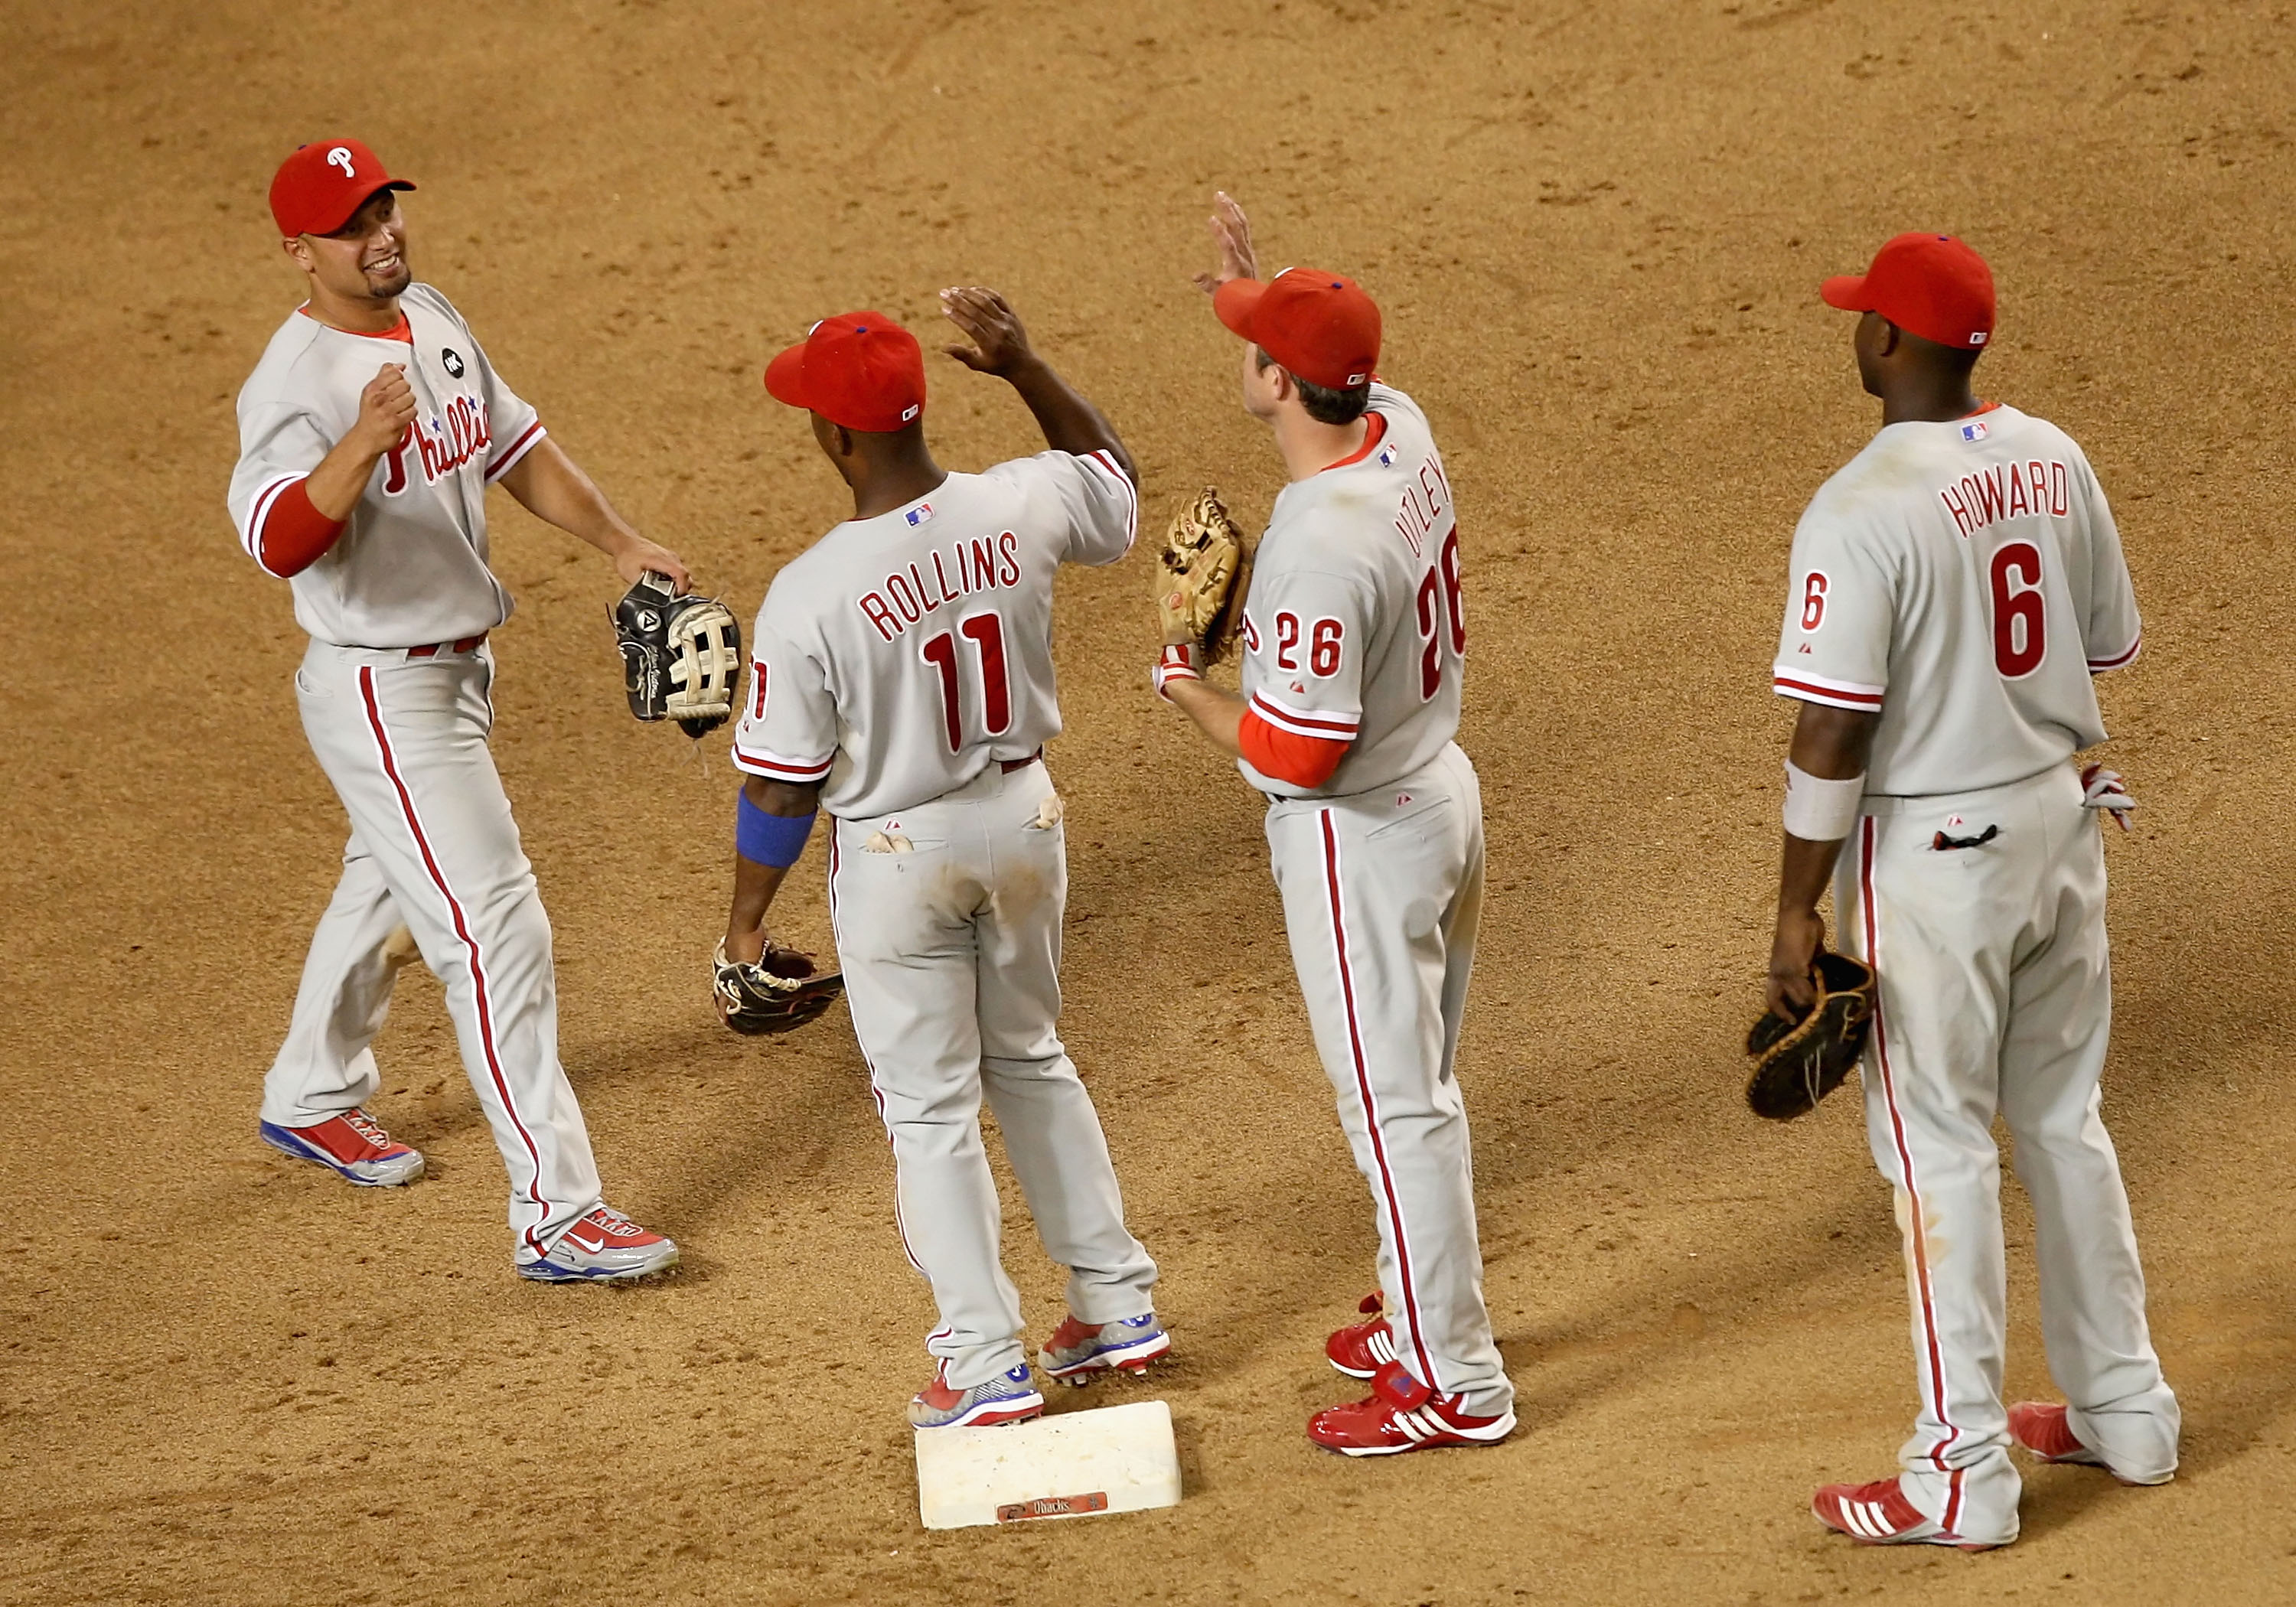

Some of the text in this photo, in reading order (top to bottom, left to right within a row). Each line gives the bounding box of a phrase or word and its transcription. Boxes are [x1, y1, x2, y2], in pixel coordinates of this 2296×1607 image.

[445, 354, 461, 372] HK
[1939, 460, 2068, 538] HOWARD
[857, 530, 1021, 642] ROLLINS
[1417, 518, 1465, 702] 26
[1799, 569, 1831, 634] 6
[1989, 539, 2047, 680] 6
[918, 609, 1013, 755] 11
[1274, 608, 1345, 680] 26
[748, 651, 771, 722] 1
